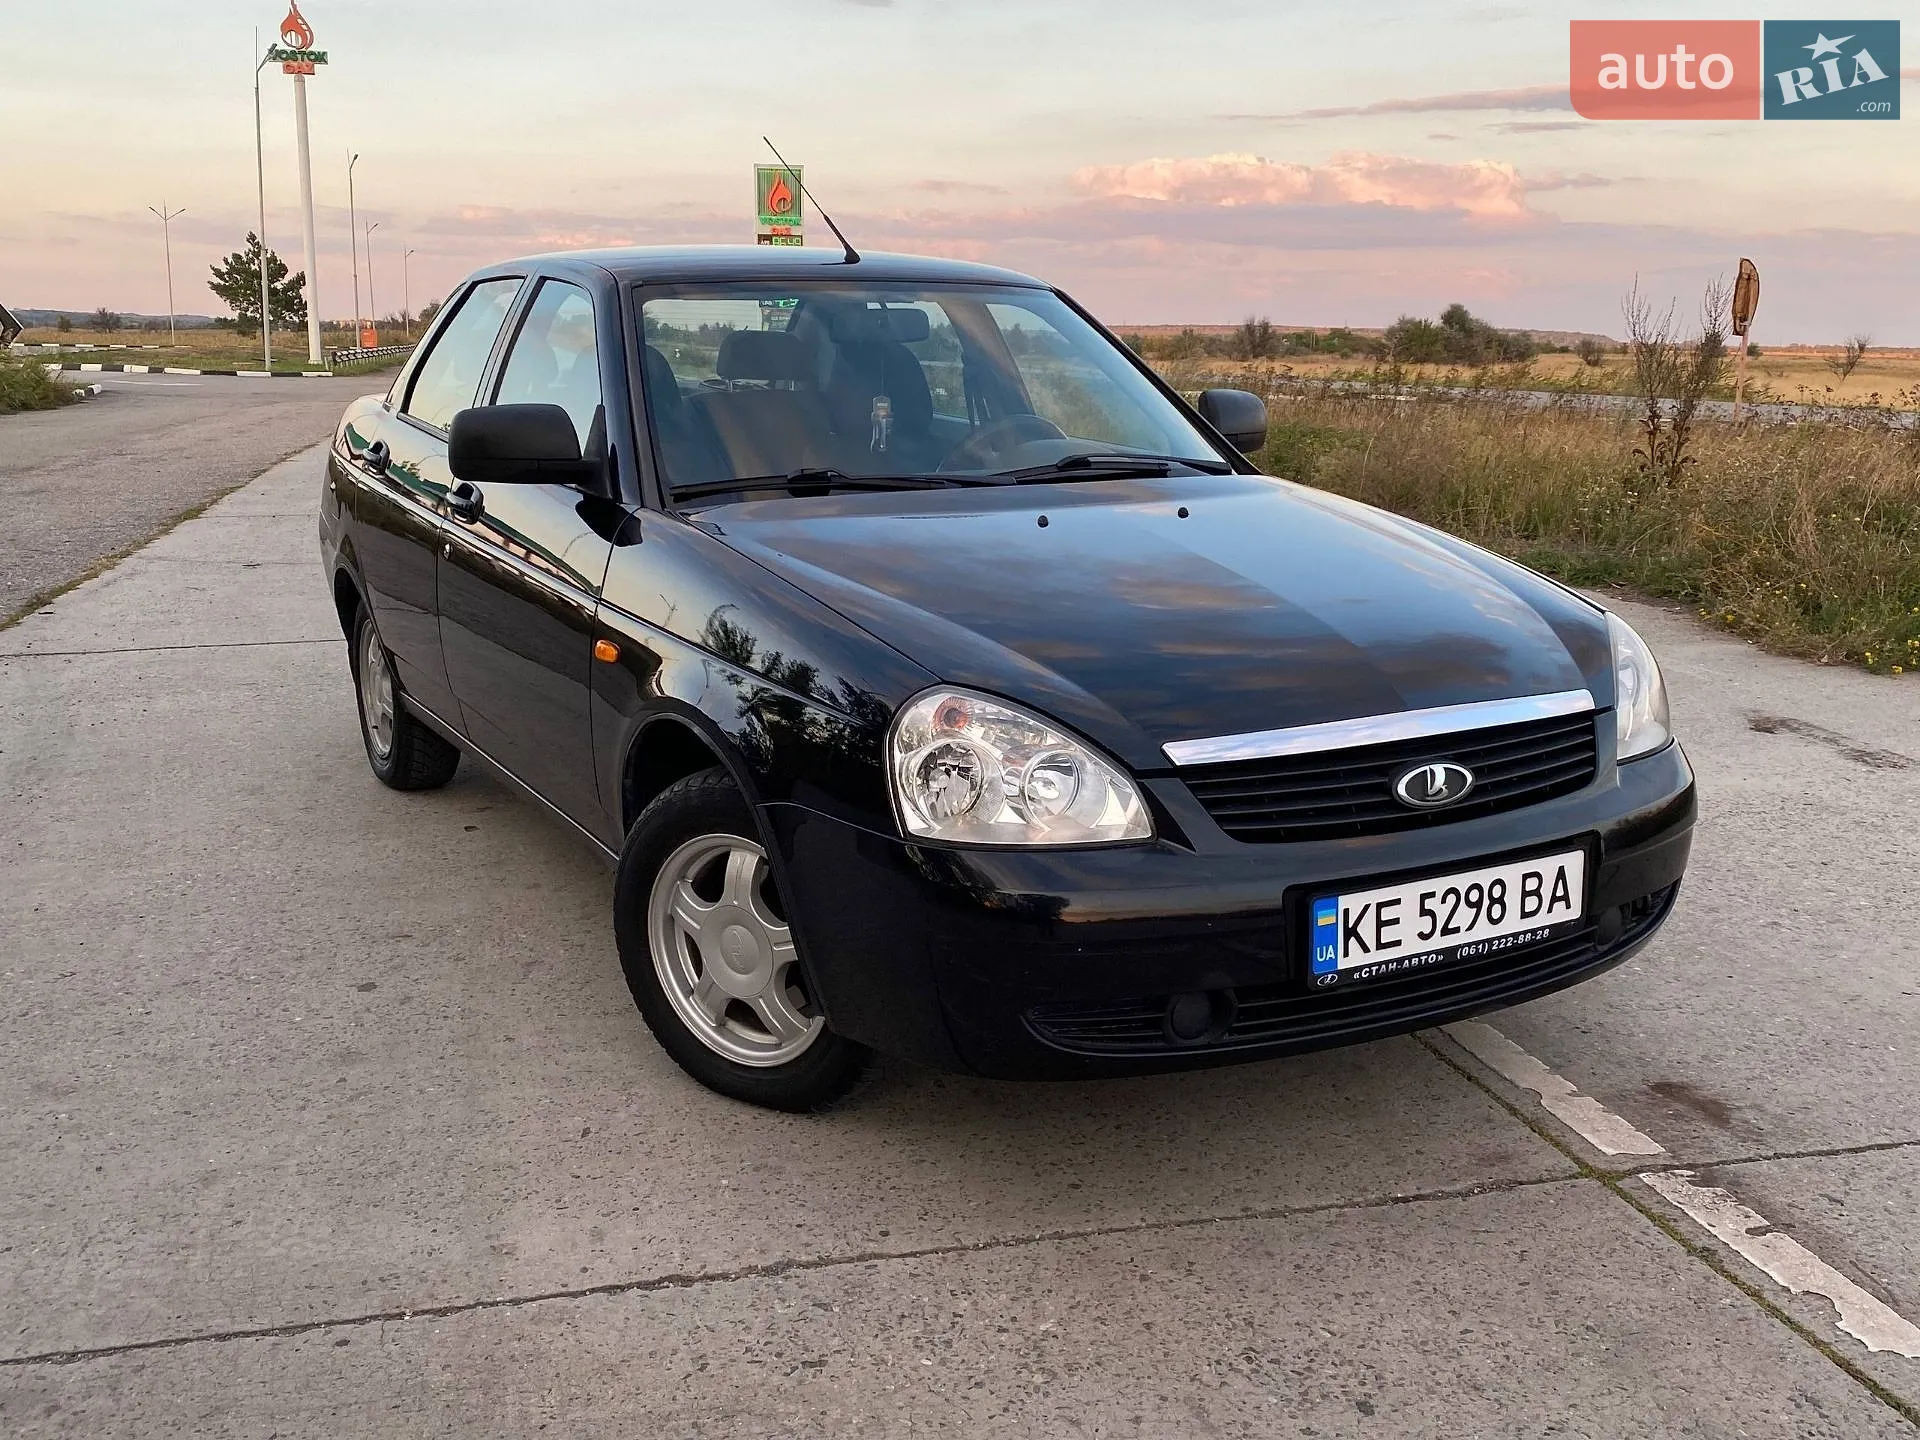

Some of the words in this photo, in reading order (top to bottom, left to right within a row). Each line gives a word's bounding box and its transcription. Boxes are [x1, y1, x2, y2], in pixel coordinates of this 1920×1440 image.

[1343, 897, 1403, 959] KE
[1417, 878, 1507, 941] 5298
[1519, 865, 1572, 920] BA
[1316, 944, 1336, 962] UA
[1457, 942, 1489, 960] (061)
[1491, 928, 1550, 951] 222-88-28
